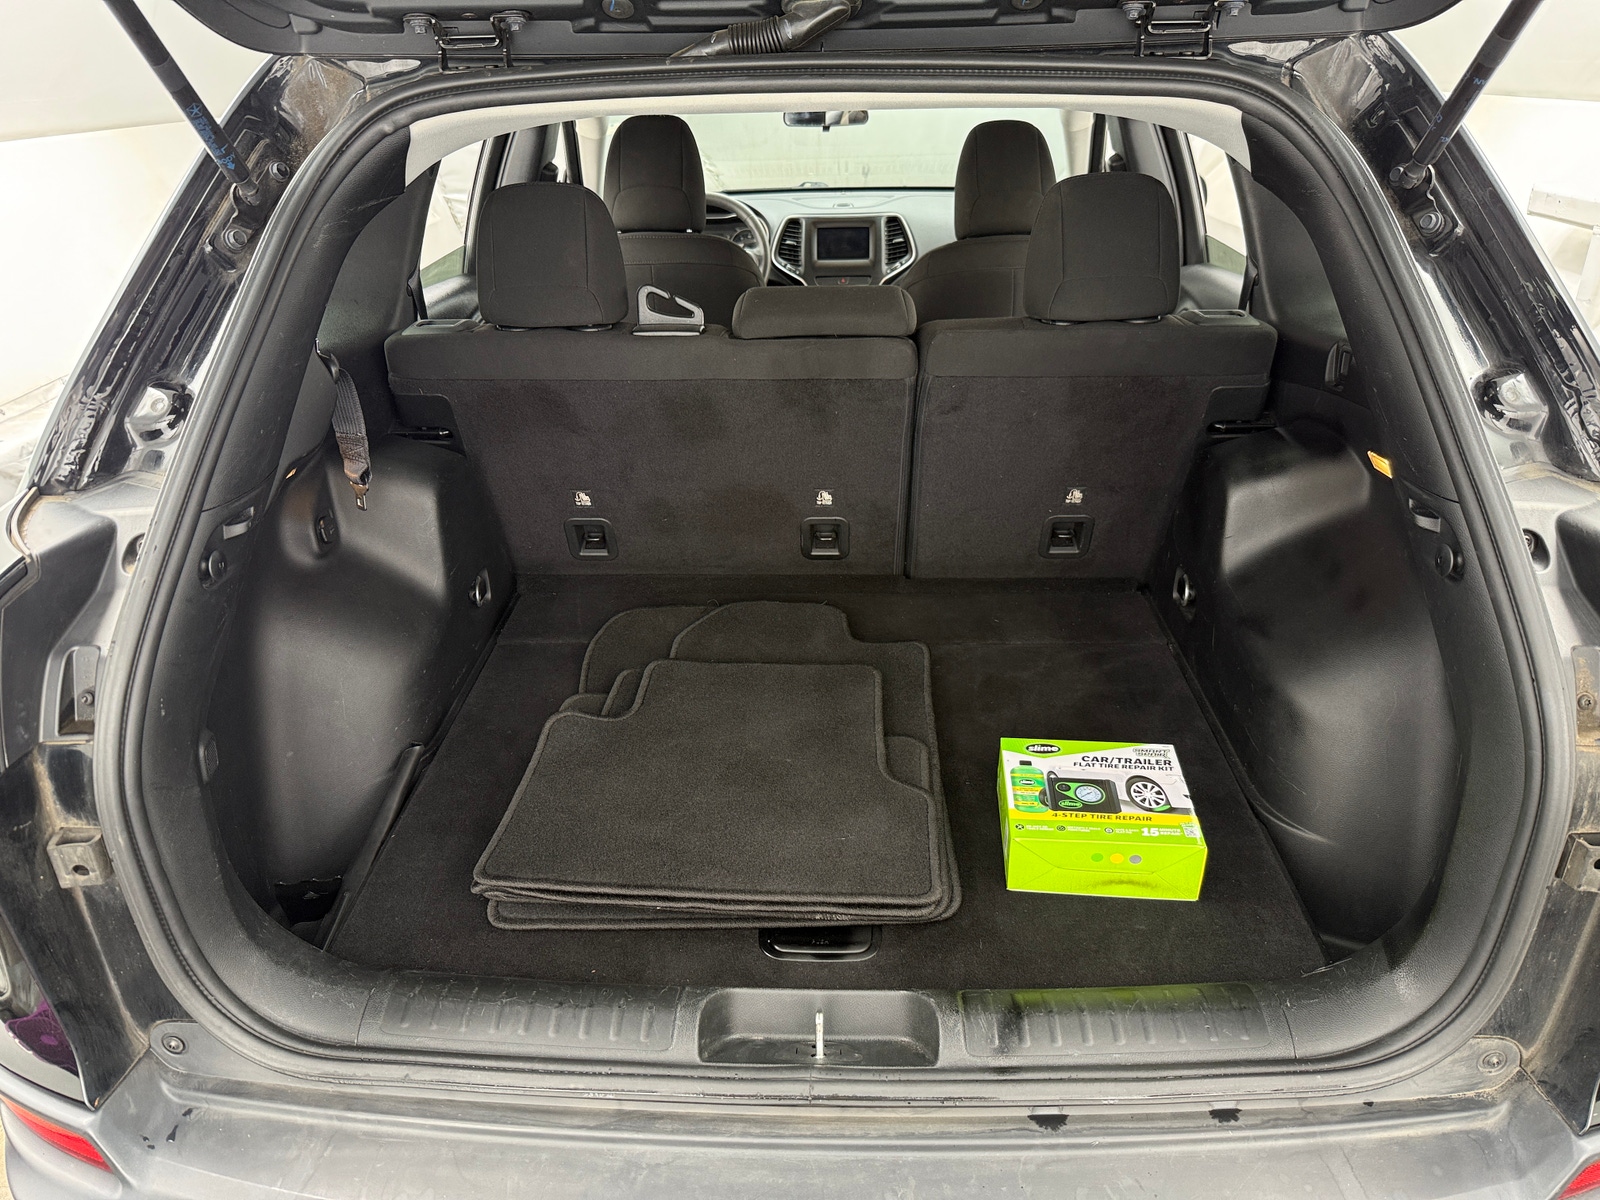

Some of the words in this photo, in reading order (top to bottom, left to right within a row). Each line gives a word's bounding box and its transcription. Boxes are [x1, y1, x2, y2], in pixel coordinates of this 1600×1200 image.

[1027, 744, 1059, 752] slime
[1081, 755, 1172, 766] CAR/TRAILER
[1141, 827, 1159, 837] 15
